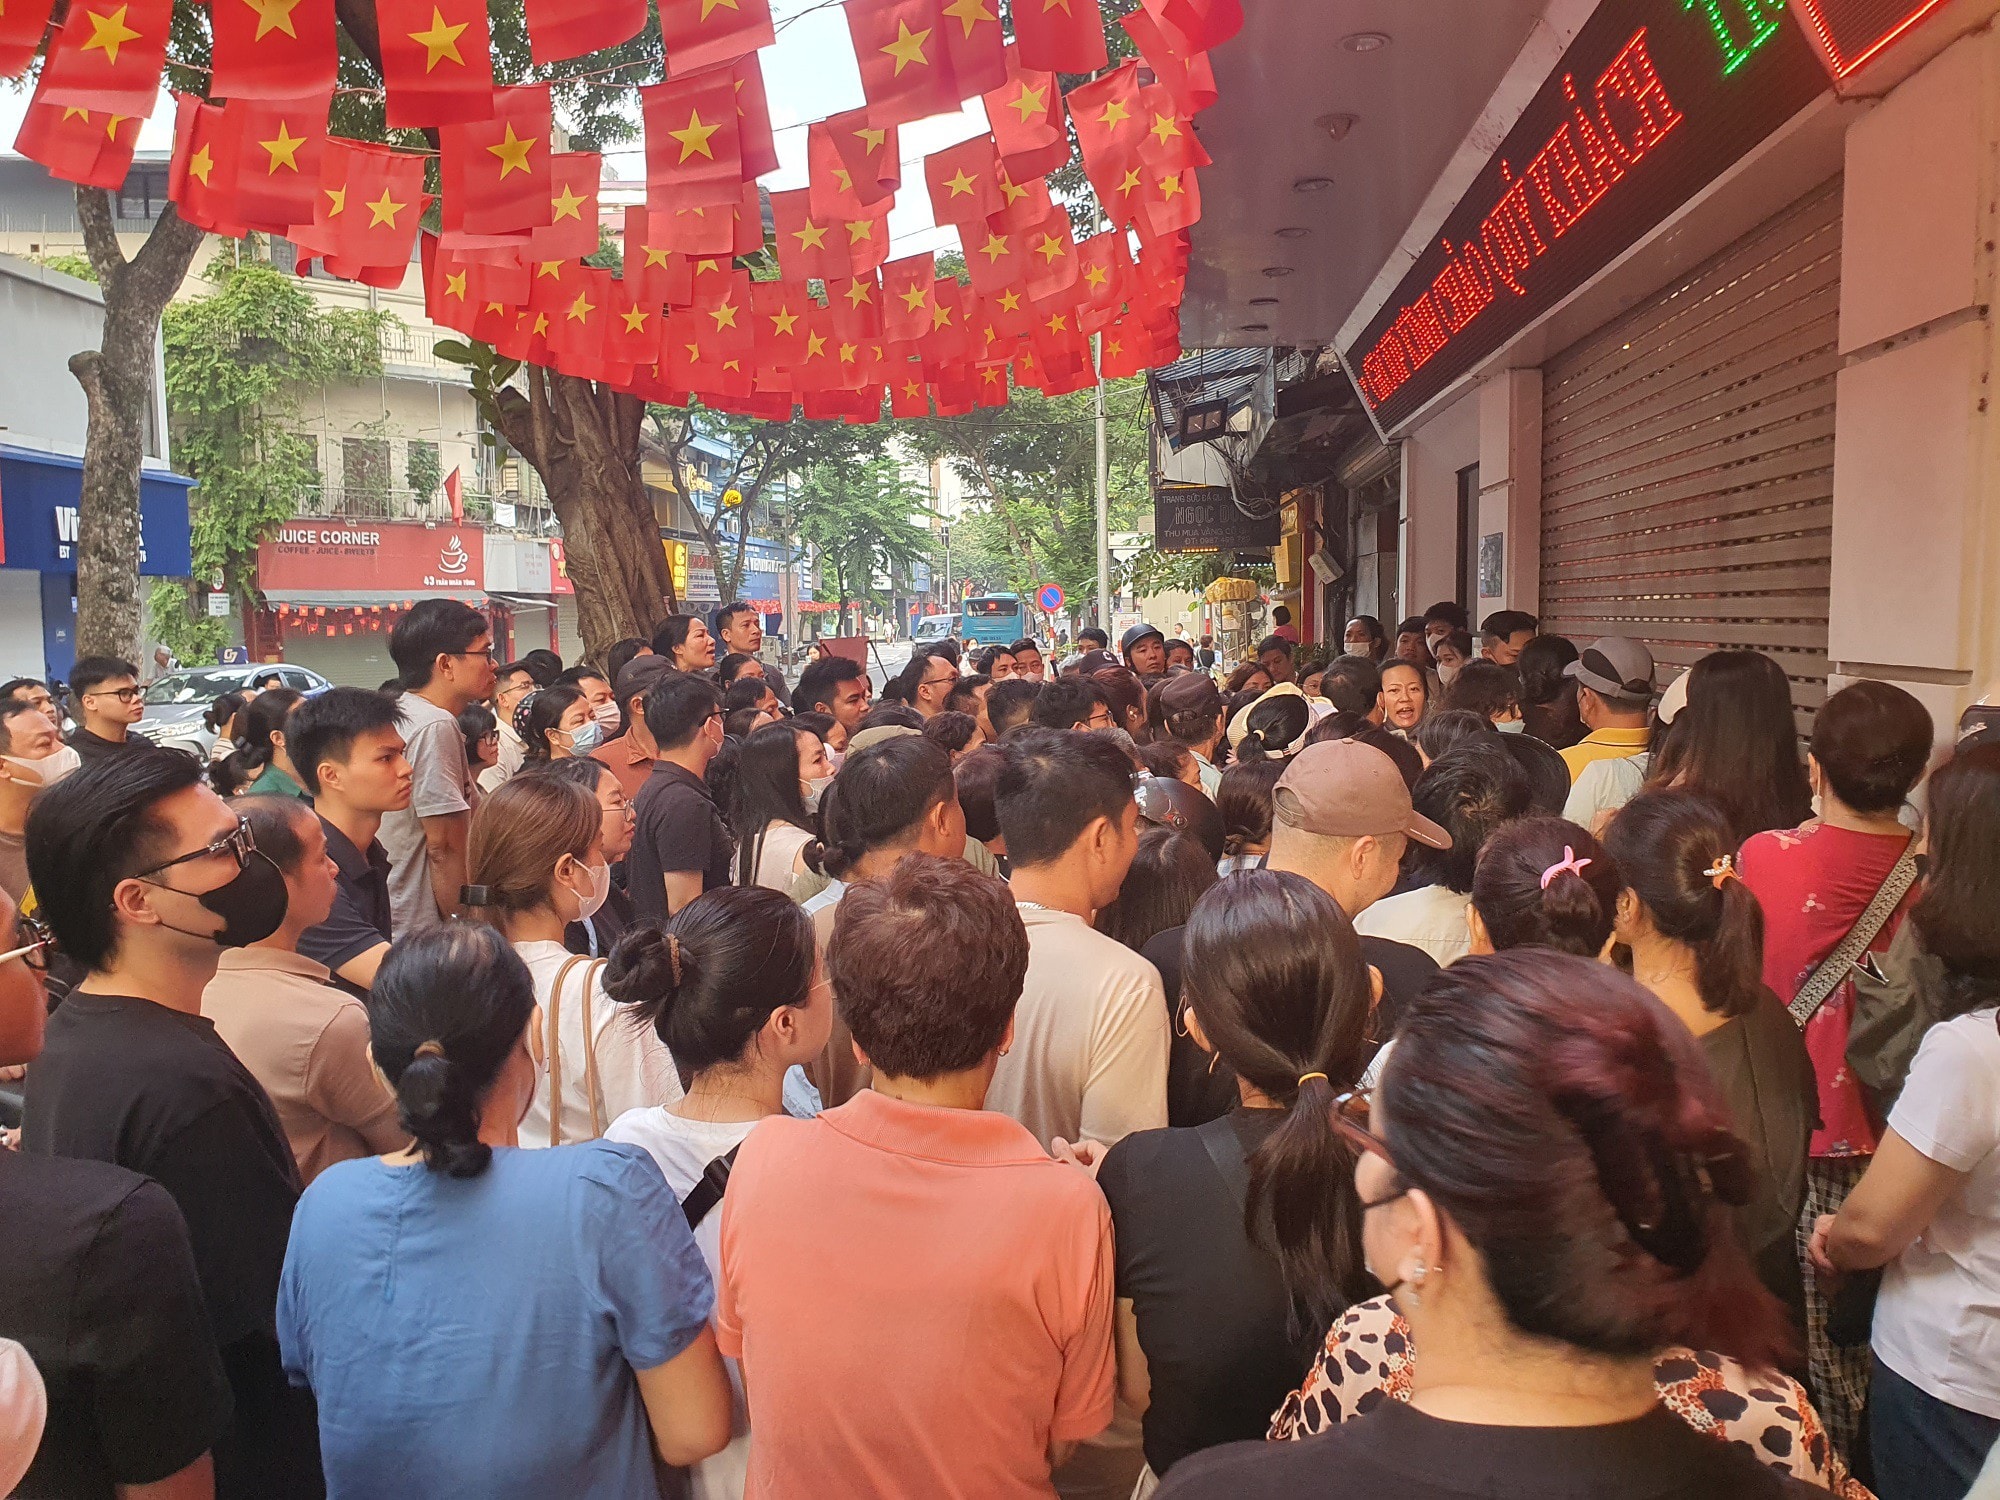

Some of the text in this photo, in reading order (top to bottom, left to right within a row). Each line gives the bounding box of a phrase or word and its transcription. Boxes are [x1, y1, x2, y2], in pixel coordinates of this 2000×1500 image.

[1431, 237, 1495, 335] CHÀO
[1480, 157, 1549, 296] QUÝ
[1526, 25, 1684, 239] KHÁCH
[1161, 495, 1185, 504] TRANG
[1175, 505, 1215, 526] NGỌC
[275, 529, 380, 546] JUICE CORNER
[1164, 530, 1181, 538] THU
[1182, 528, 1200, 537] MUA
[59, 545, 70, 559] EST
[277, 545, 375, 556] COFFEE JUICE SWEETS
[423, 575, 435, 586] 43
